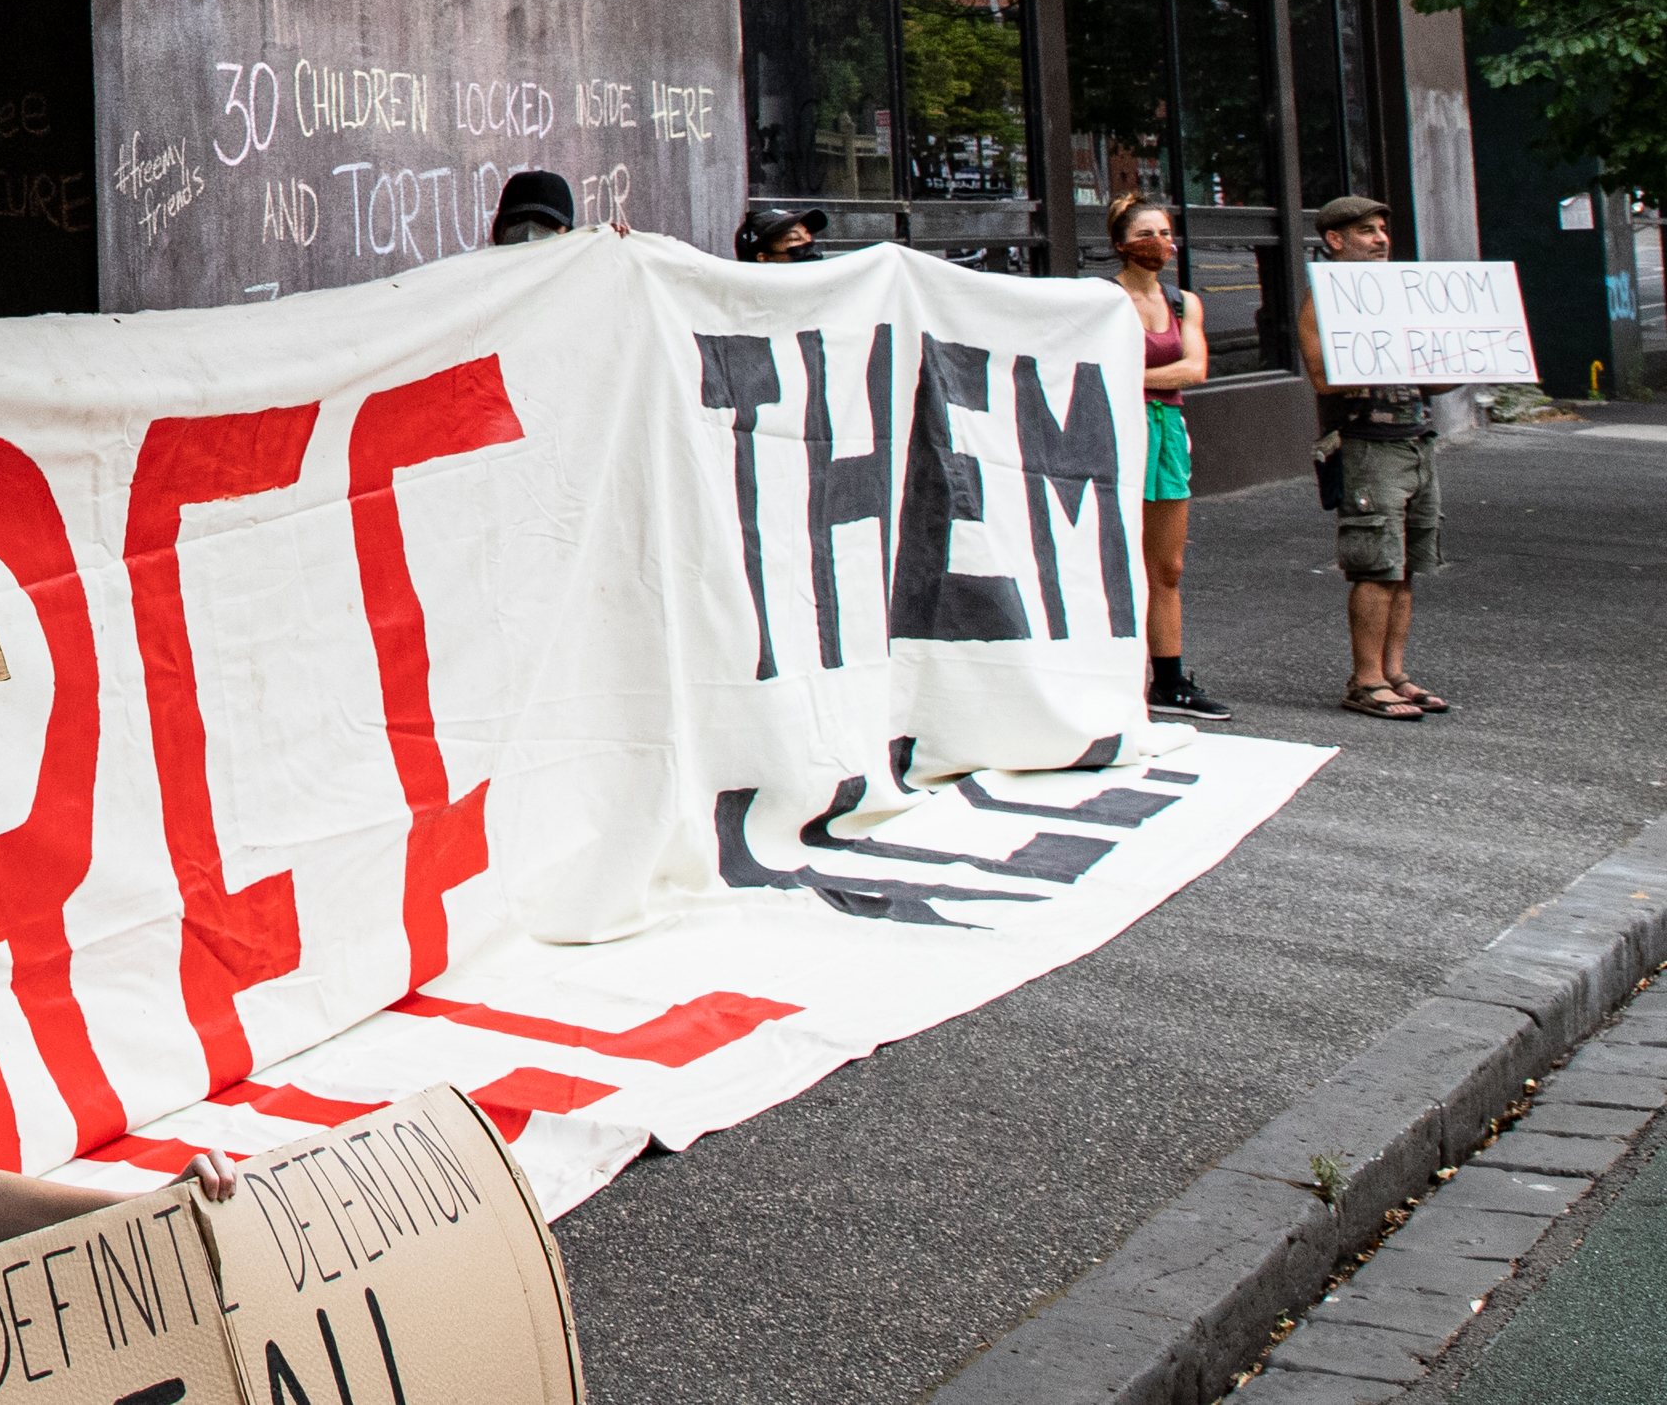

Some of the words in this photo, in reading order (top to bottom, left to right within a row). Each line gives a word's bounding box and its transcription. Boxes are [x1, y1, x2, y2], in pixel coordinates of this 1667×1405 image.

[213, 61, 280, 166] 30
[294, 59, 428, 138] CHILDREN
[455, 81, 556, 140] LOCKED
[574, 78, 637, 128] INSIDE
[651, 80, 715, 143] HERE
[138, 166, 205, 247] friends
[262, 179, 319, 248] AND
[331, 161, 542, 263] TORTUR
[582, 162, 631, 228] FOR
[1329, 270, 1385, 316] NO
[1400, 269, 1499, 315] ROOM
[1331, 330, 1402, 376] FOR
[1407, 329, 1532, 375] RACISTS
[692, 323, 1137, 681] THEM
[243, 1110, 481, 1292] DETENTION
